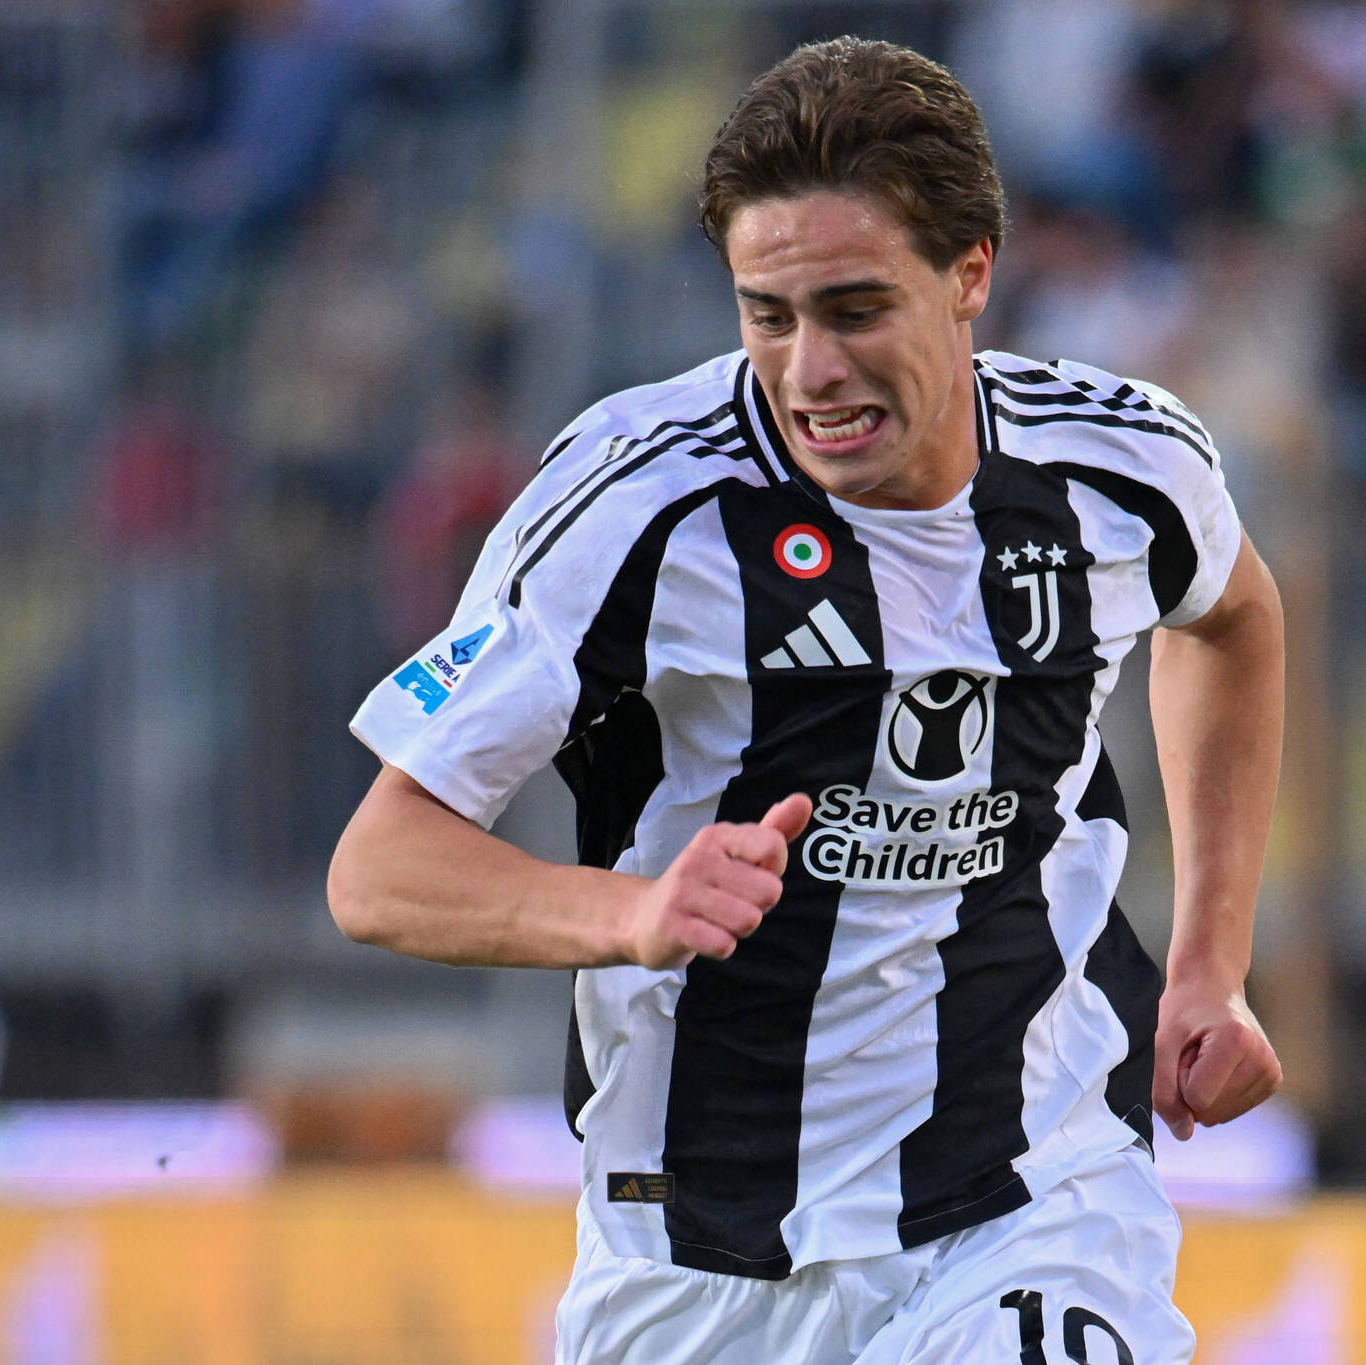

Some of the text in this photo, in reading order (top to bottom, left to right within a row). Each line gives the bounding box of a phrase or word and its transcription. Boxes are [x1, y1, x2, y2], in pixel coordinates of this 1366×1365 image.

[430, 654, 457, 679] SERIE
[818, 787, 1014, 833] Save the
[808, 833, 1000, 881] Children
